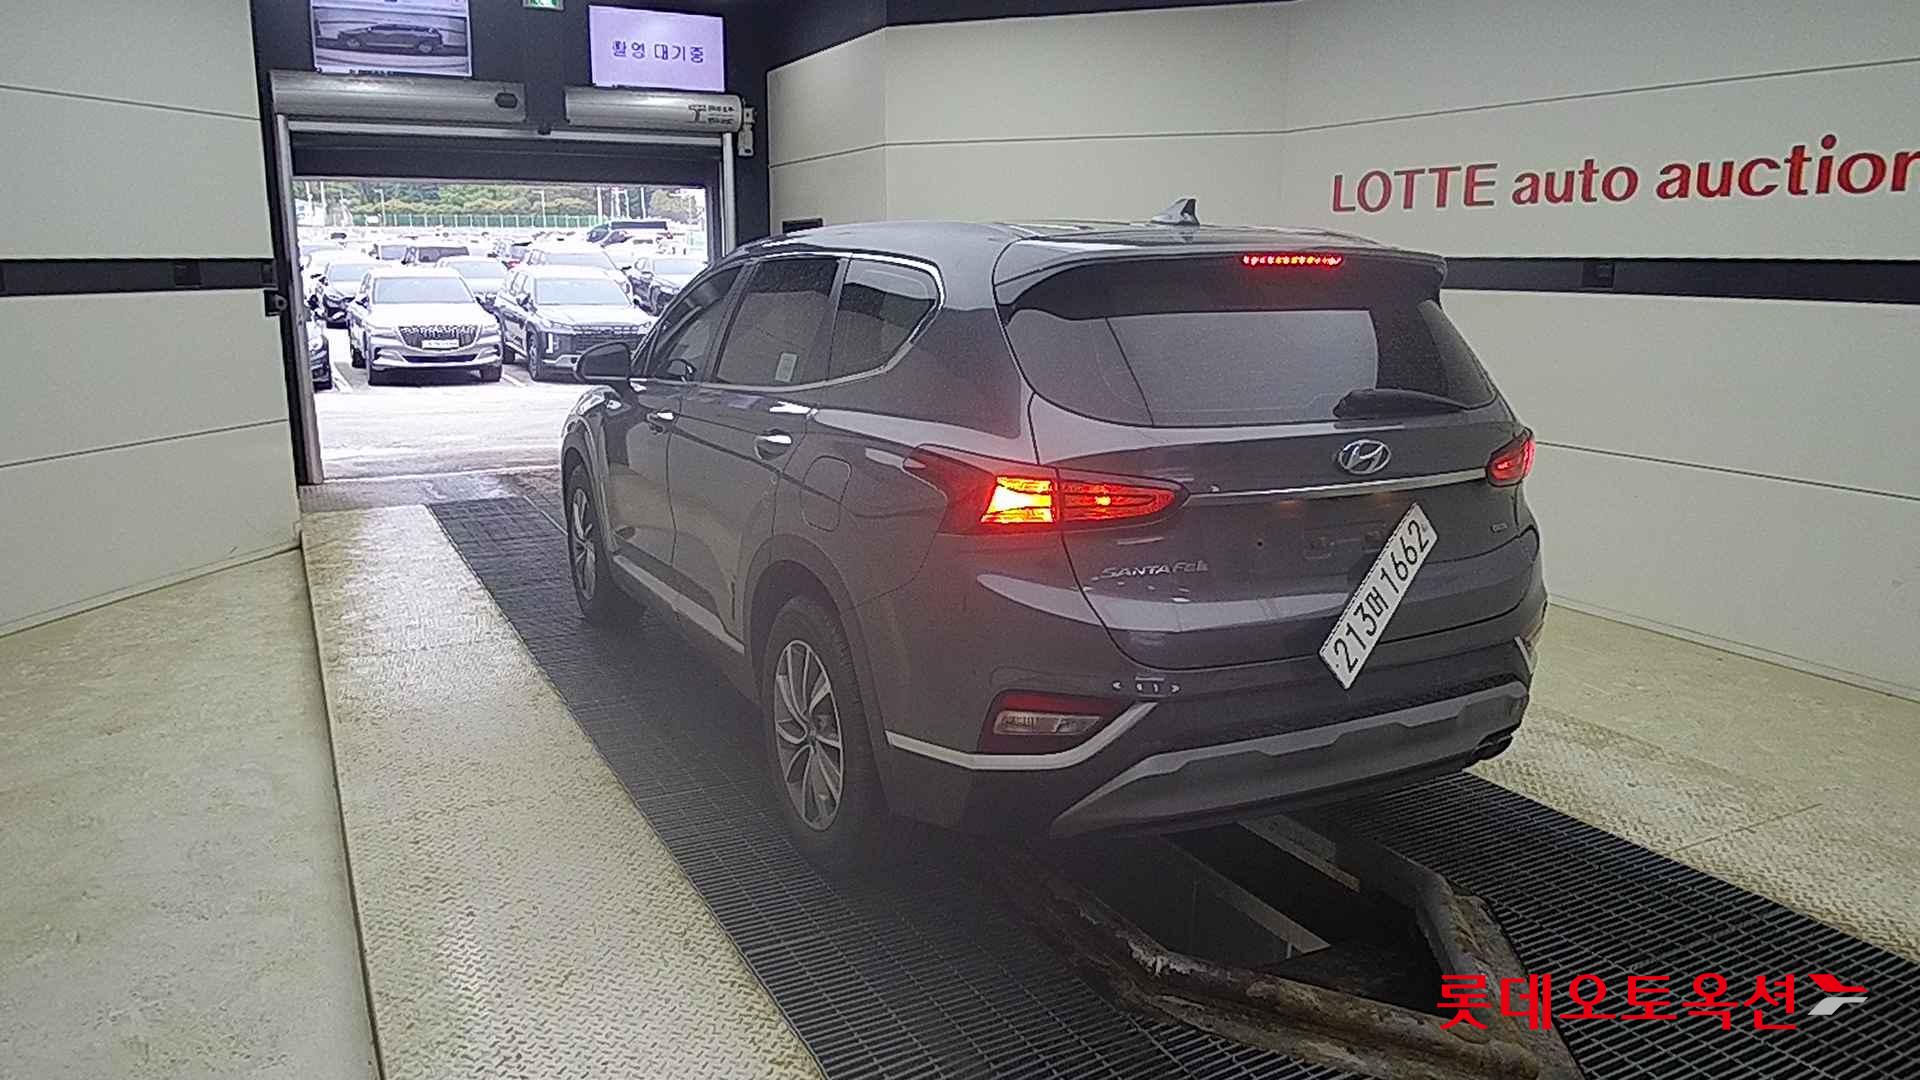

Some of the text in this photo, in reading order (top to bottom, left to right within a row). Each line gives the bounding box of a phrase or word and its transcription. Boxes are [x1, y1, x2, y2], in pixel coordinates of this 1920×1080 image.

[654, 43, 704, 63] 대기중
[1331, 163, 1498, 212] LOTTE
[1511, 158, 1638, 205] auto
[1333, 519, 1430, 674] 213머 1662
